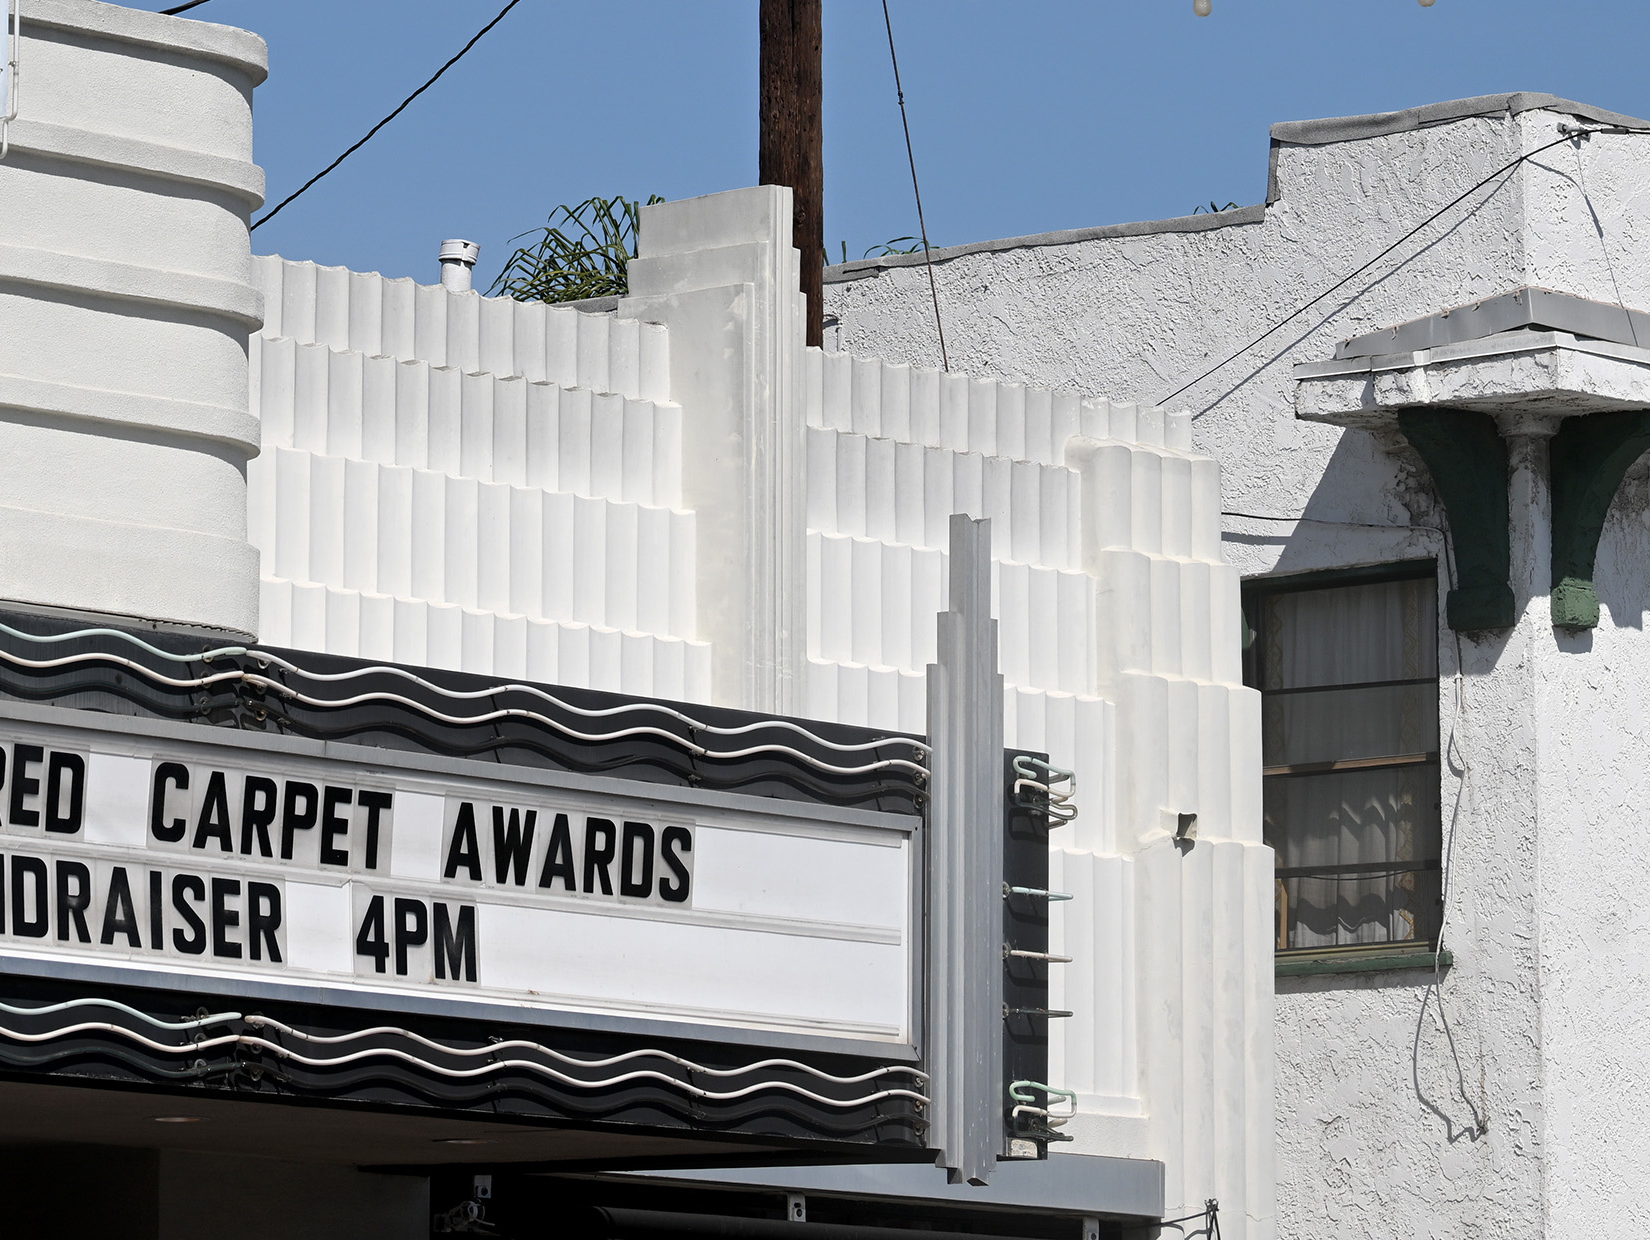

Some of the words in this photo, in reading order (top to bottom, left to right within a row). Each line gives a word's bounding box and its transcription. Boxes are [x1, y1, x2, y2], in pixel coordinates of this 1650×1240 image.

[152, 762, 392, 869] CARPET
[444, 802, 691, 902] AWARDS
[356, 895, 477, 982] 4PM
